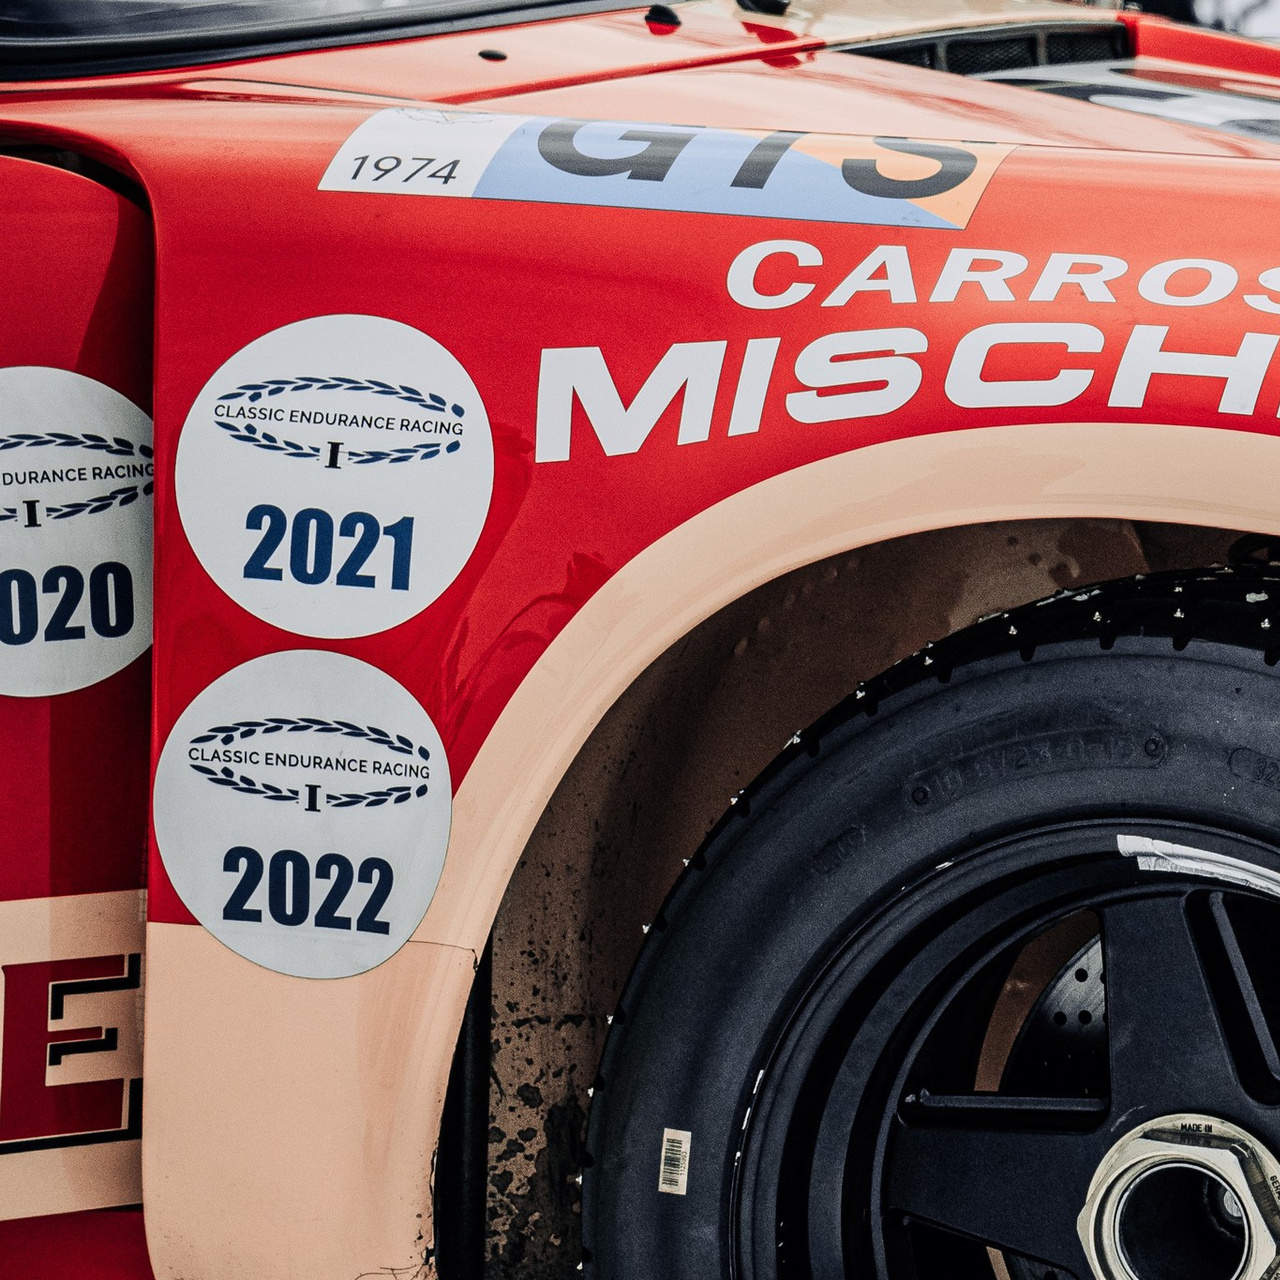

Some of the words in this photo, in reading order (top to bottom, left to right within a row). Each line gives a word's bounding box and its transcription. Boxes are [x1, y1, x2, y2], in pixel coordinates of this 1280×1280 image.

[350, 154, 461, 185] 1974
[213, 404, 285, 422] CLASSIC
[290, 409, 395, 431] ENDURANCE
[400, 420, 464, 436] RACING
[0, 467, 87, 486] DURANCE
[92, 463, 154, 481] RACING
[243, 504, 415, 590] 2021
[188, 747, 260, 765] CLASSIC
[264, 752, 368, 773] ENDURANCE
[372, 760, 431, 780] RACING
[222, 846, 394, 935] 2022
[1180, 1122, 1203, 1133] MADE
[1204, 1123, 1213, 1134] IN
